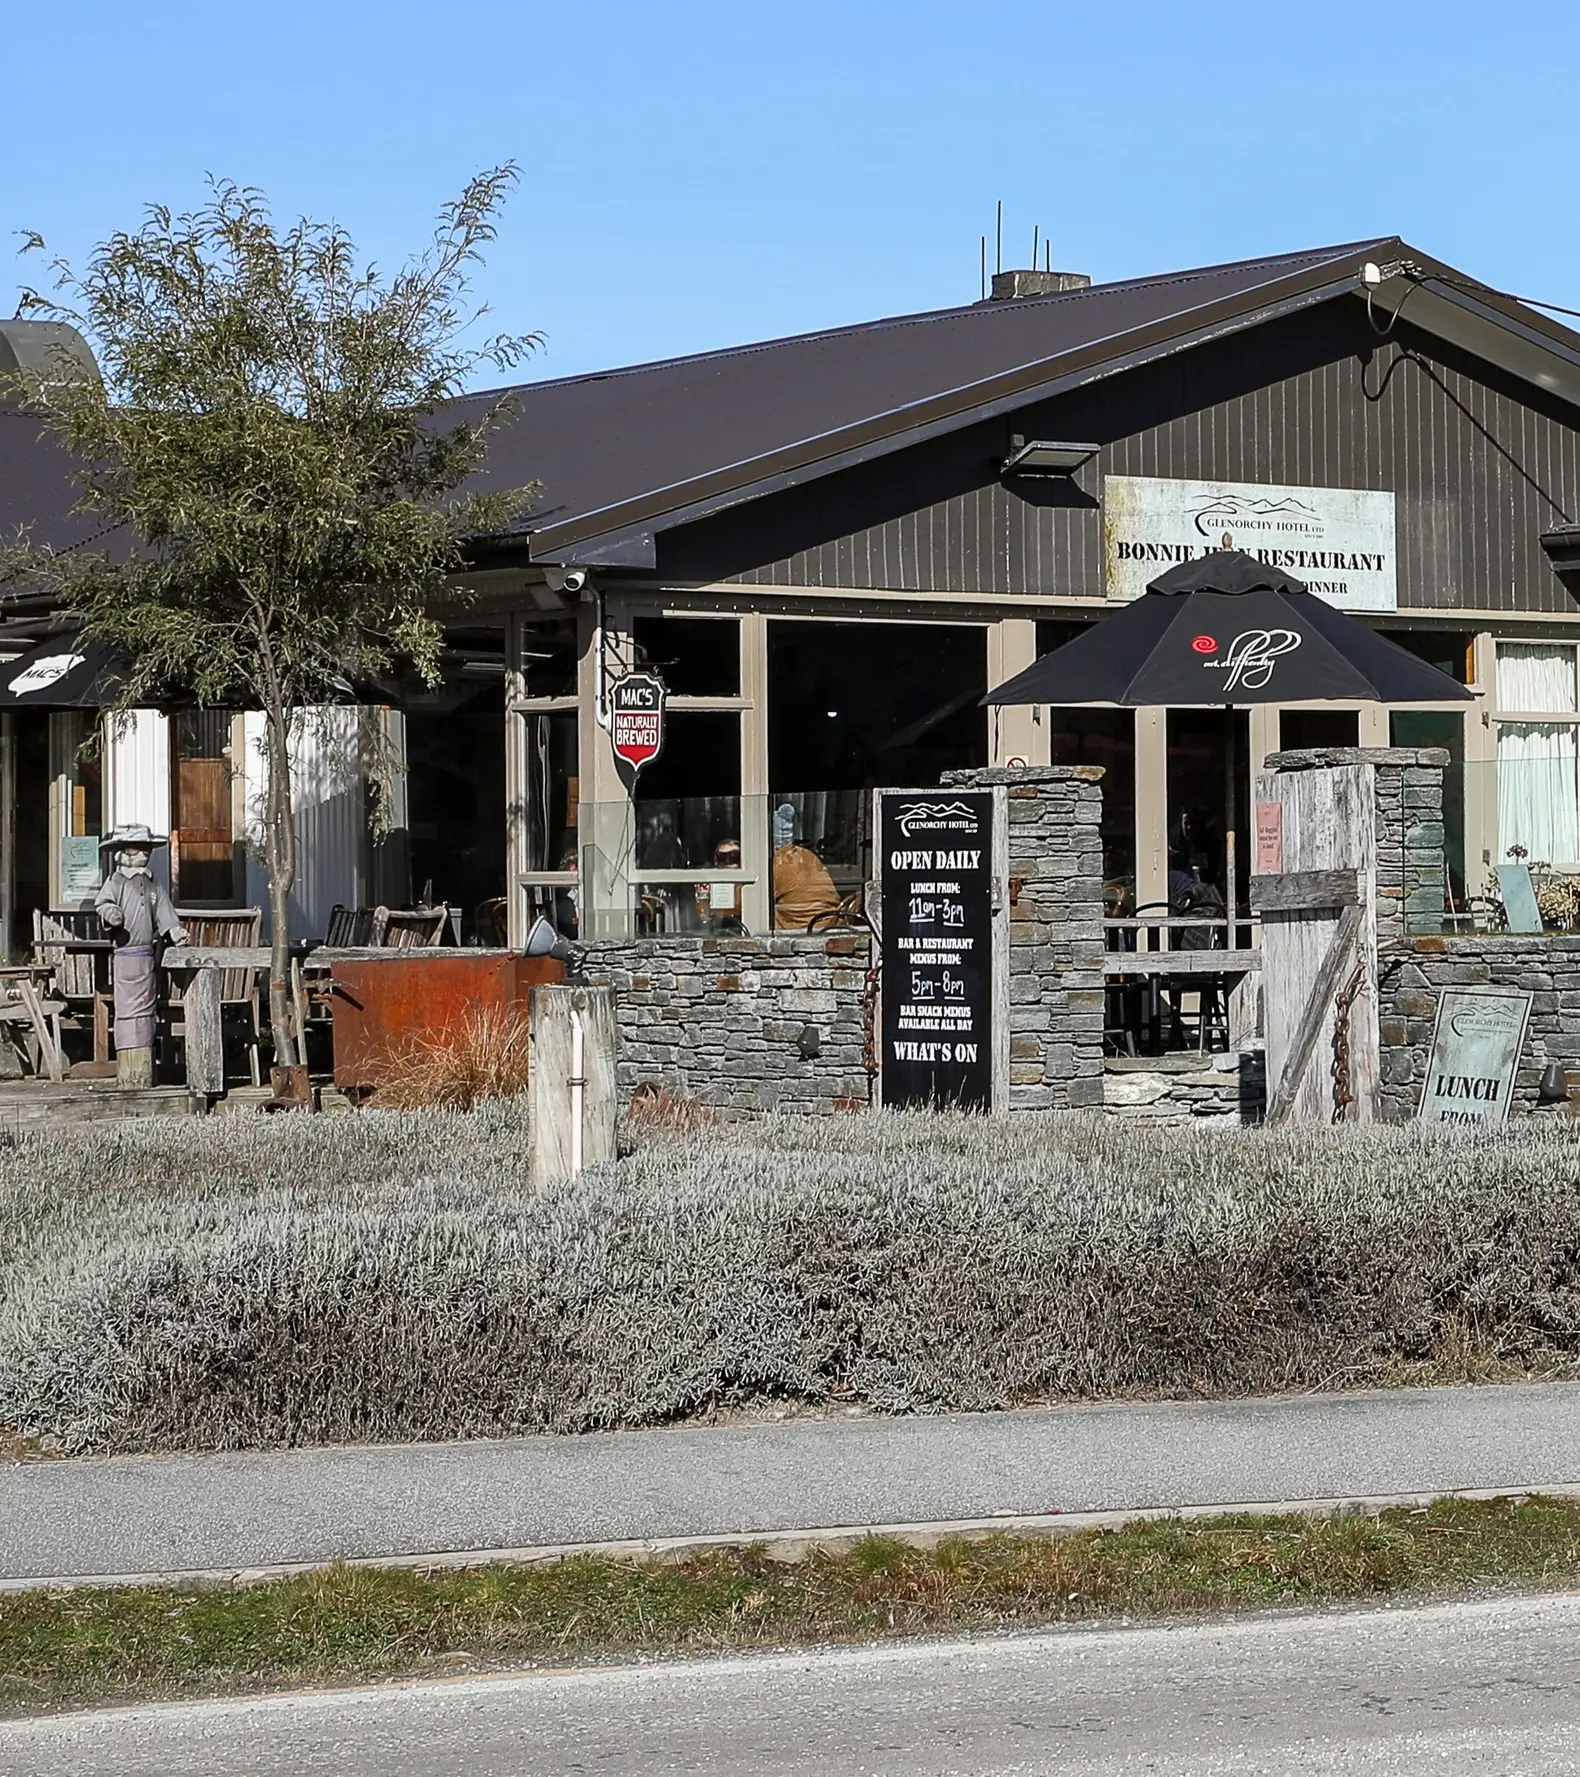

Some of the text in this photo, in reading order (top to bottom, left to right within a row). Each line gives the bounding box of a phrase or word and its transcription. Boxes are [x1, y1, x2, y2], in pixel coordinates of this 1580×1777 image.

[1207, 518, 1273, 530] GLENORCHY
[1276, 521, 1311, 532] HOTEL
[1117, 541, 1195, 562] BONNIE
[1257, 548, 1386, 572] RESTAURANT
[621, 687, 654, 706] MAC'S
[616, 715, 658, 729] NATURALLY
[616, 729, 657, 746] BREWED
[908, 821, 947, 829] GLENORCHY
[948, 820, 969, 829] HOTEL
[891, 850, 981, 870] OPEN DAILY
[910, 882, 961, 894] LUNCH FROM:
[898, 938, 974, 949] BAR & RESTAURANT
[910, 953, 962, 965] MENUS FROM:
[900, 1005, 971, 1017] BAR SNACK MENUS
[898, 1018, 973, 1031] AVAILABLE ALL DAY
[893, 1041, 978, 1063] WHAT'S ON
[1435, 1075, 1500, 1101] LUNCH
